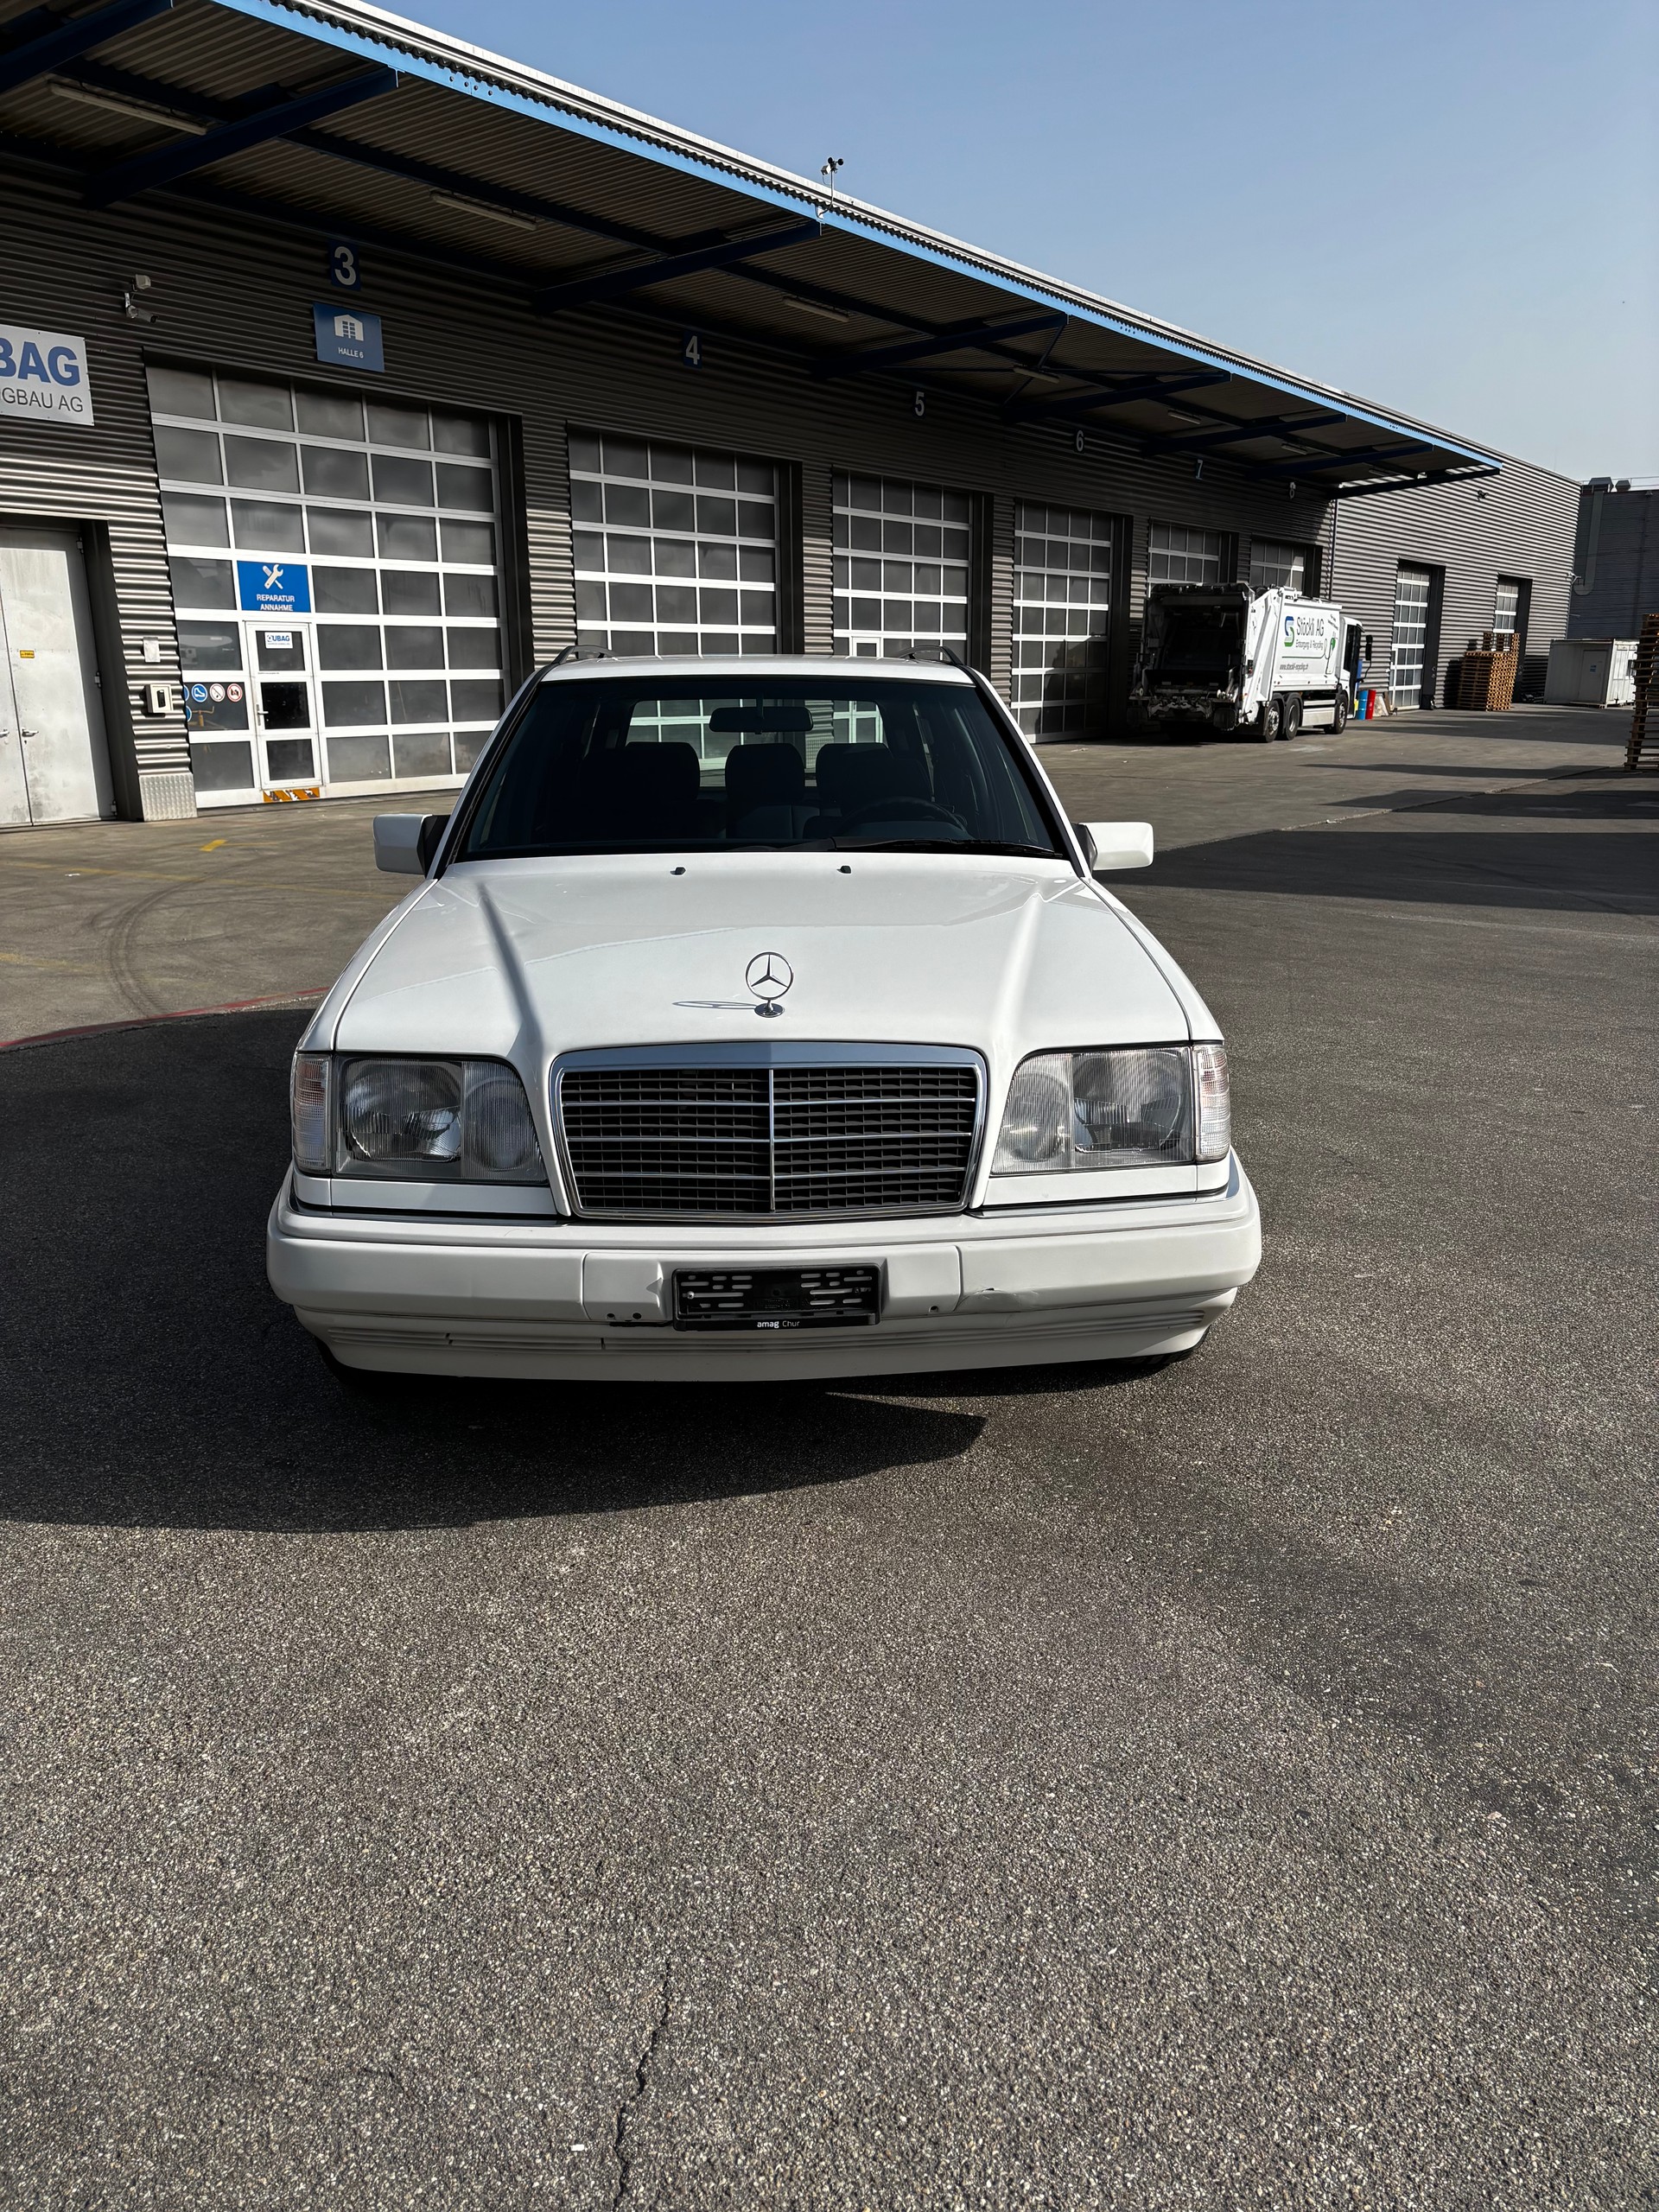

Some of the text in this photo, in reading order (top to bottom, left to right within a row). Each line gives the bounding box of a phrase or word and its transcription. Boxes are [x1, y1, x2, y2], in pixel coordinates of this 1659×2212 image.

[334, 246, 357, 286] 3
[338, 347, 359, 357] HALLE
[685, 335, 700, 365] 4
[58, 395, 84, 412] AG
[915, 391, 925, 416] 5
[1076, 429, 1084, 452] 6
[257, 594, 295, 602] REPARATUR
[1316, 618, 1325, 637] AG
